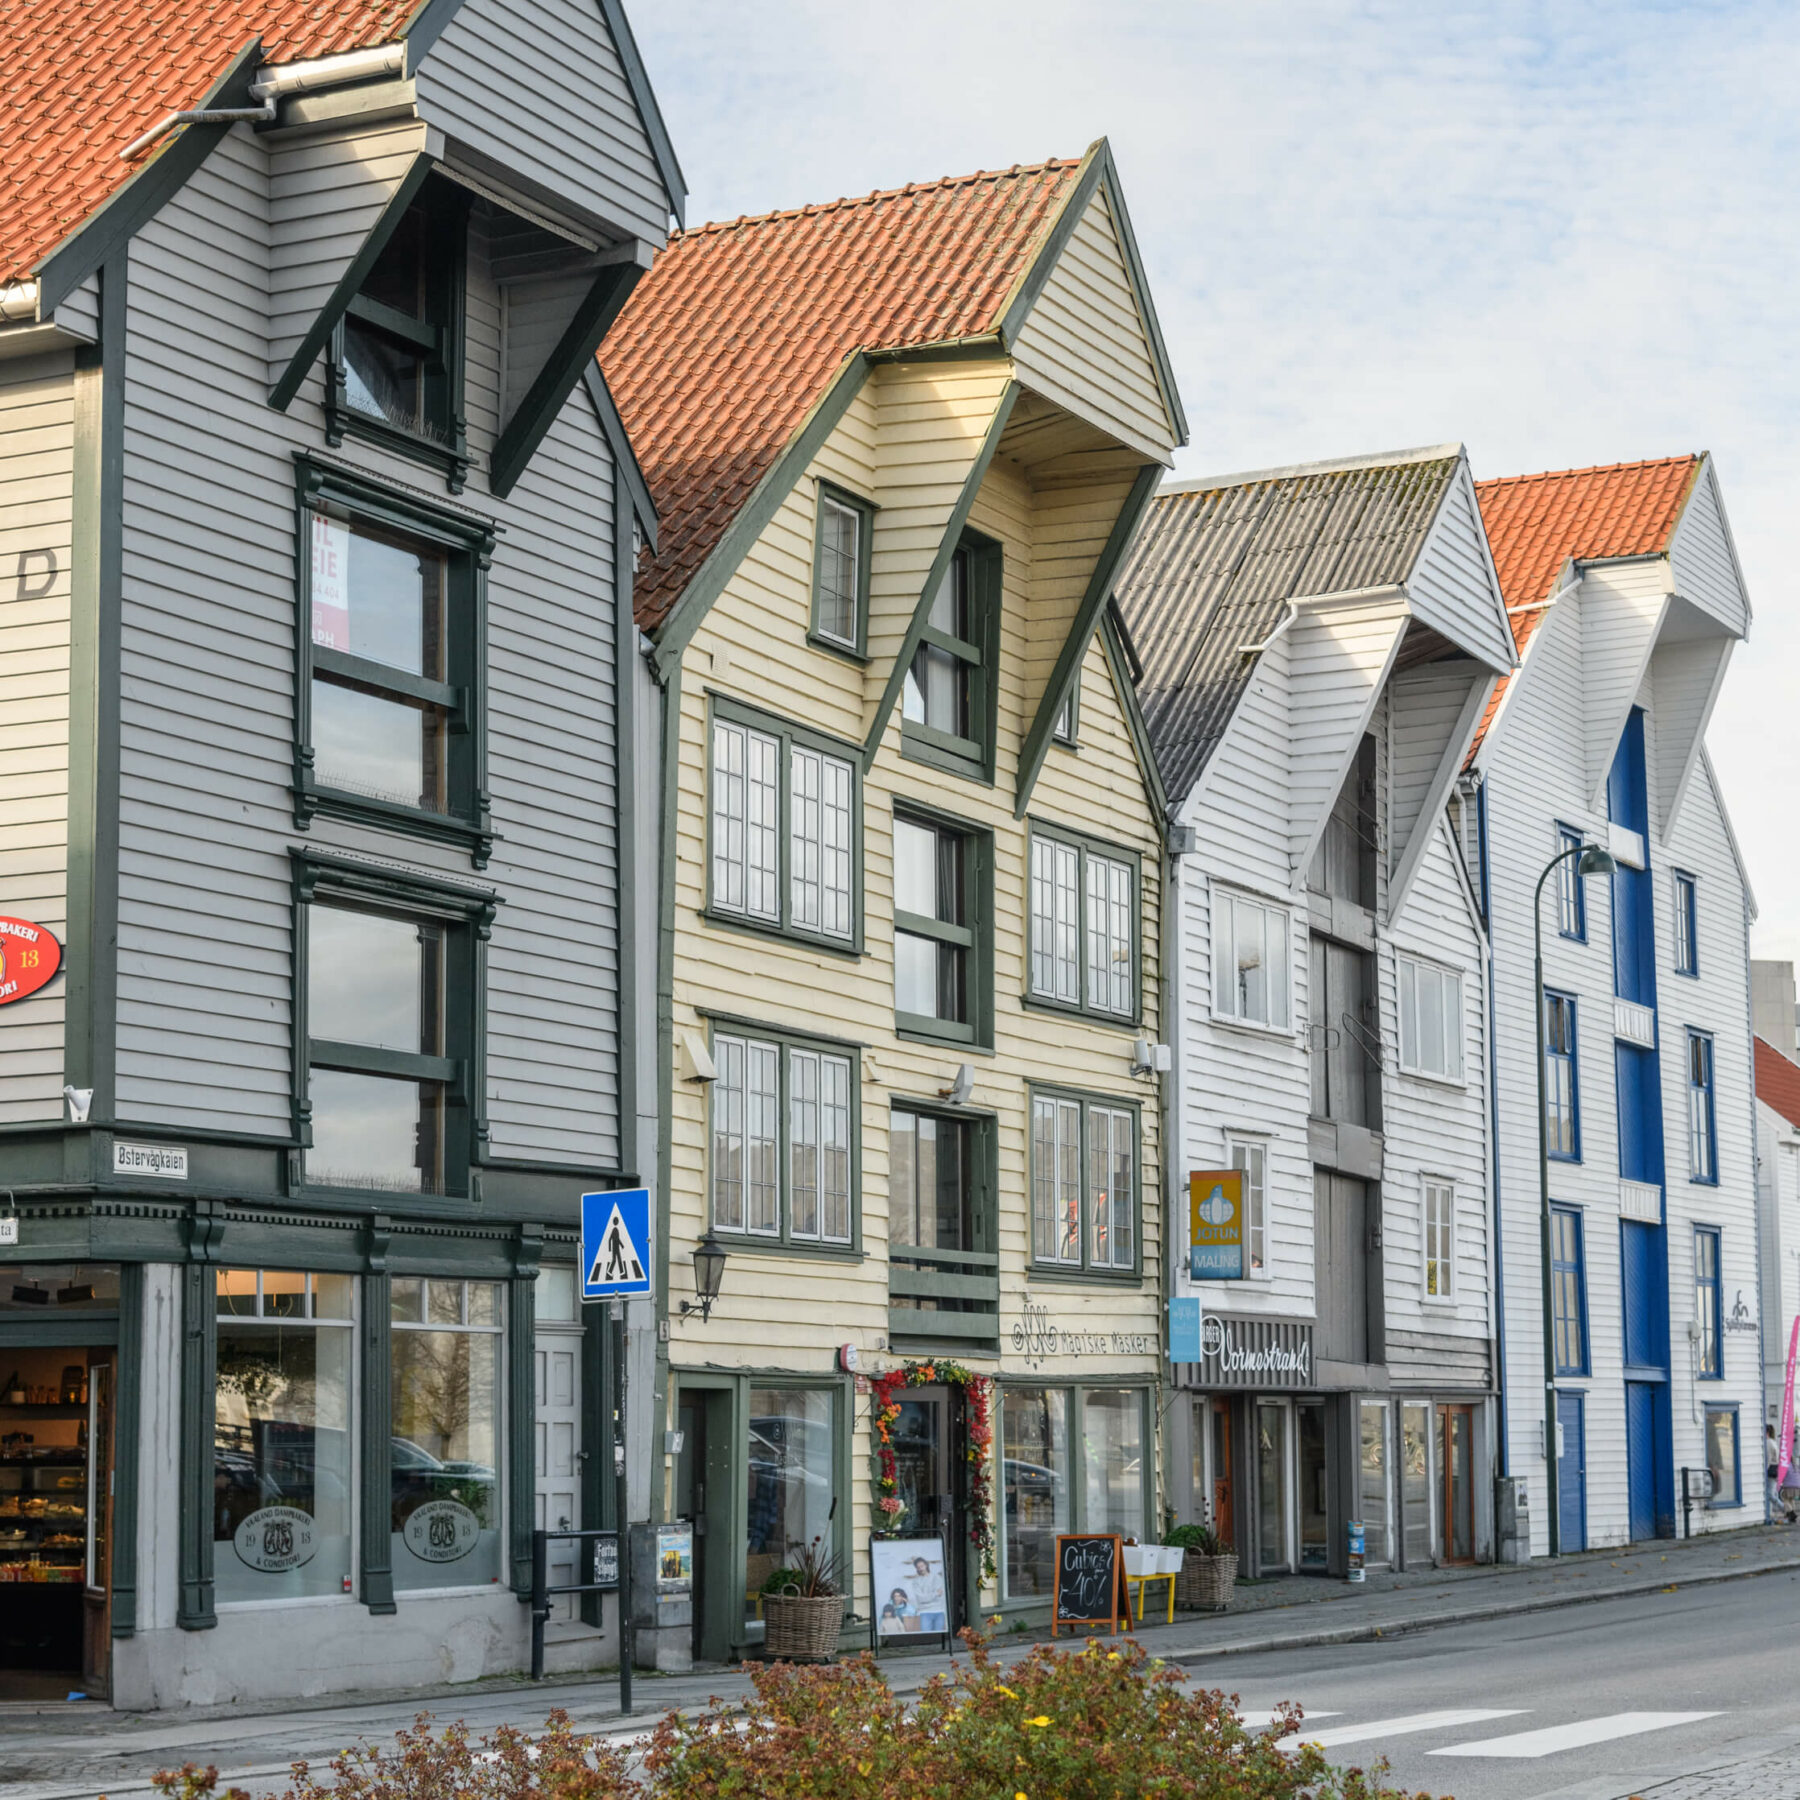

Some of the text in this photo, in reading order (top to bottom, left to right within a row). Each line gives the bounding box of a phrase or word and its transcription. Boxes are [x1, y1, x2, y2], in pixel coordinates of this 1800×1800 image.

[17, 548, 58, 601] D
[21, 949, 39, 968] 13
[118, 1146, 184, 1172] Østervågkaien
[1195, 1227, 1239, 1240] JOTUN
[1194, 1255, 1239, 1269] MALING
[1061, 1328, 1149, 1356] Magiske Masker
[1220, 1328, 1308, 1377] Vormestrand
[245, 1534, 256, 1548] 19
